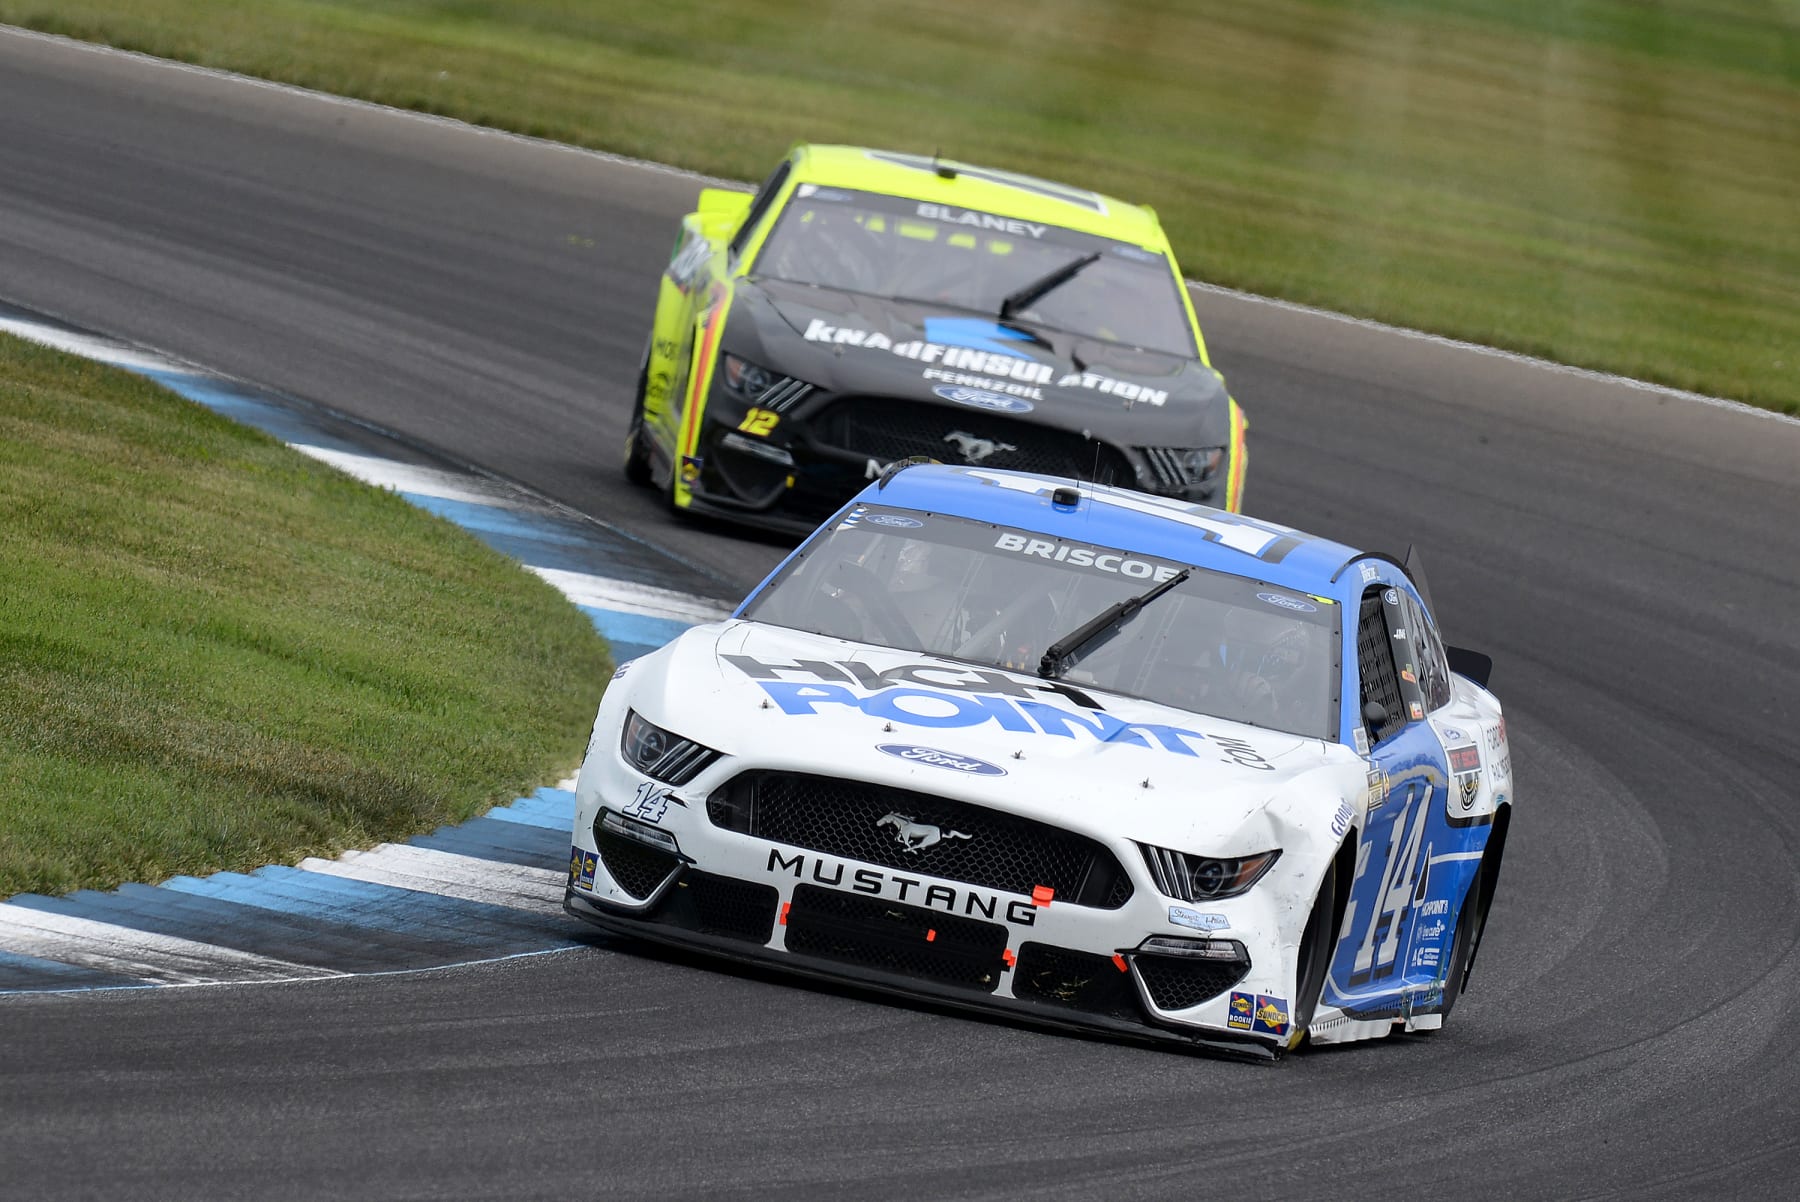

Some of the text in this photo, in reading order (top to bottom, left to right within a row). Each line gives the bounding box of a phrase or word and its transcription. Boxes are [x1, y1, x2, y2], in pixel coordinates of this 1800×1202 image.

[916, 202, 1047, 239] BLANEY
[922, 368, 1044, 401] PENNZOIL
[737, 406, 781, 437] 12
[994, 532, 1180, 583] BRISCOE
[1267, 594, 1307, 611] Ford
[755, 680, 1206, 758] POINT
[897, 745, 985, 773] Ford
[622, 781, 674, 824] 14
[1330, 801, 1355, 837] GOOD
[766, 848, 1038, 927] MUSTANG
[1352, 784, 1434, 974] 14
[1229, 1014, 1251, 1025] ROOKIE
[1256, 1008, 1288, 1023] SUNOCO
